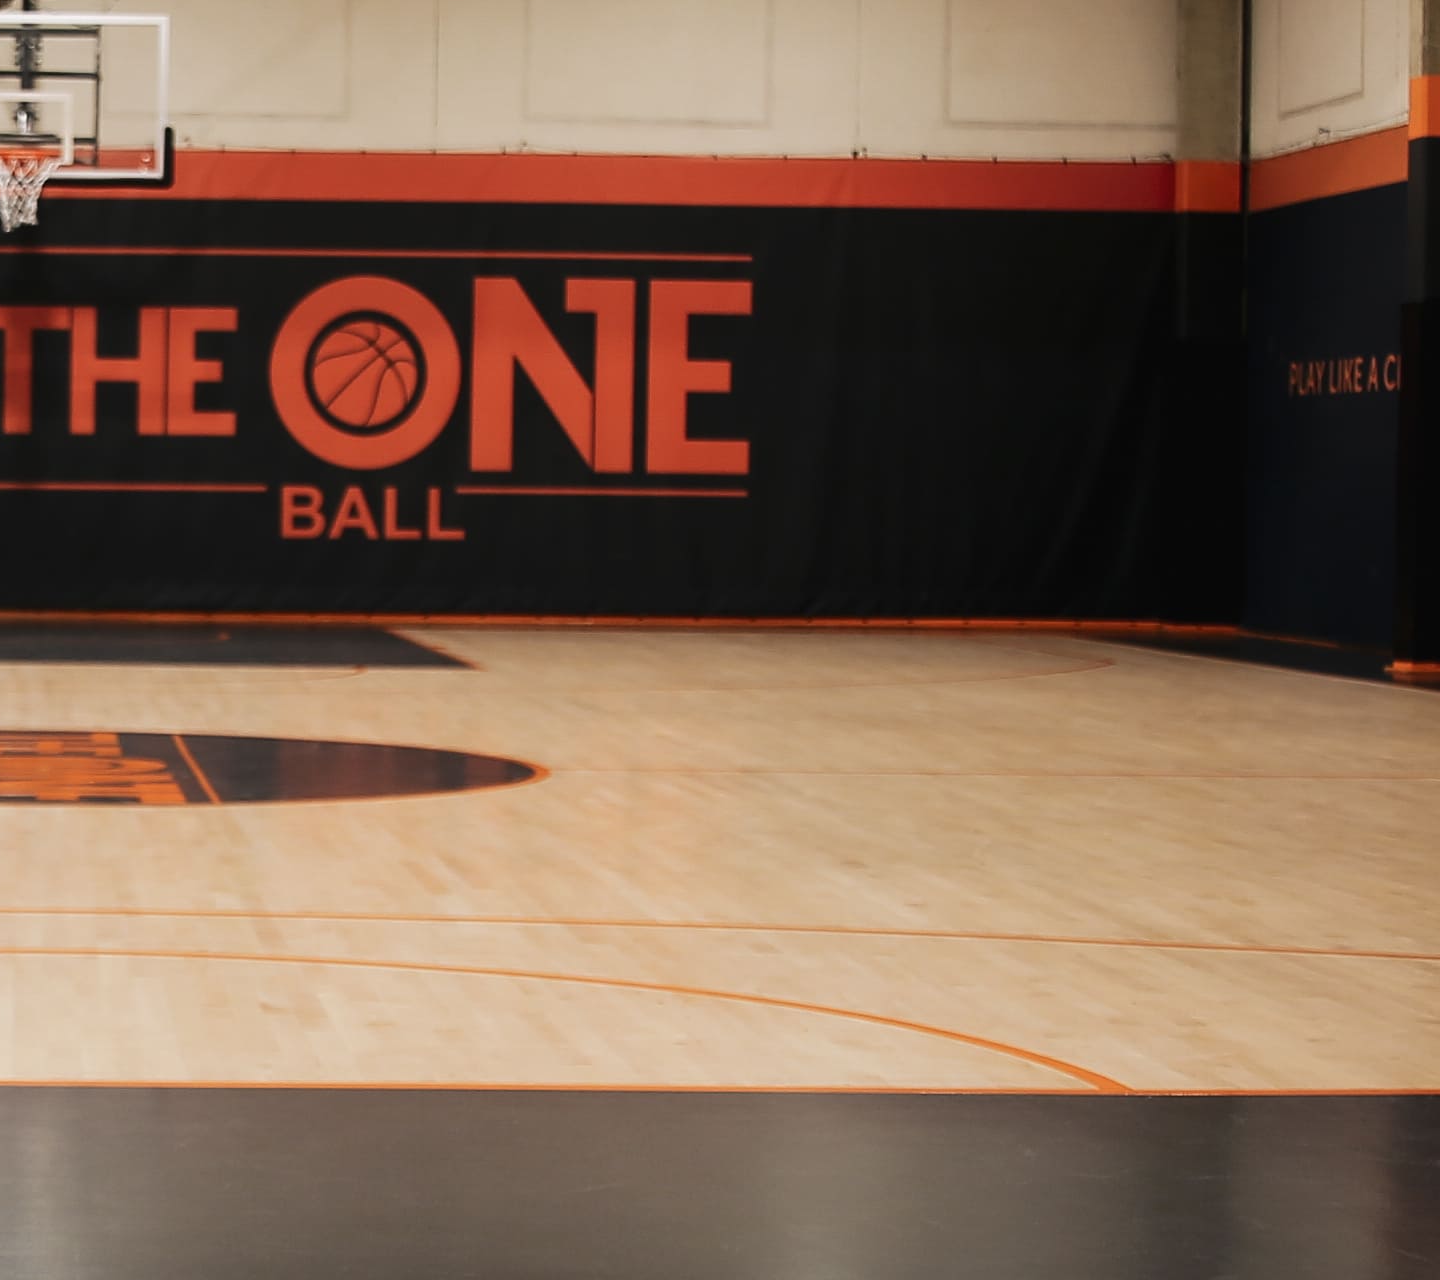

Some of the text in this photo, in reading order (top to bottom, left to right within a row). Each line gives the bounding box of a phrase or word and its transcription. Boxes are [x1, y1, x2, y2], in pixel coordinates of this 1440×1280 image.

[267, 274, 753, 476] ONE
[1288, 360, 1326, 397] PLAY
[1328, 356, 1365, 394] LIKE
[1367, 354, 1380, 392] A
[279, 485, 465, 541] BALL
